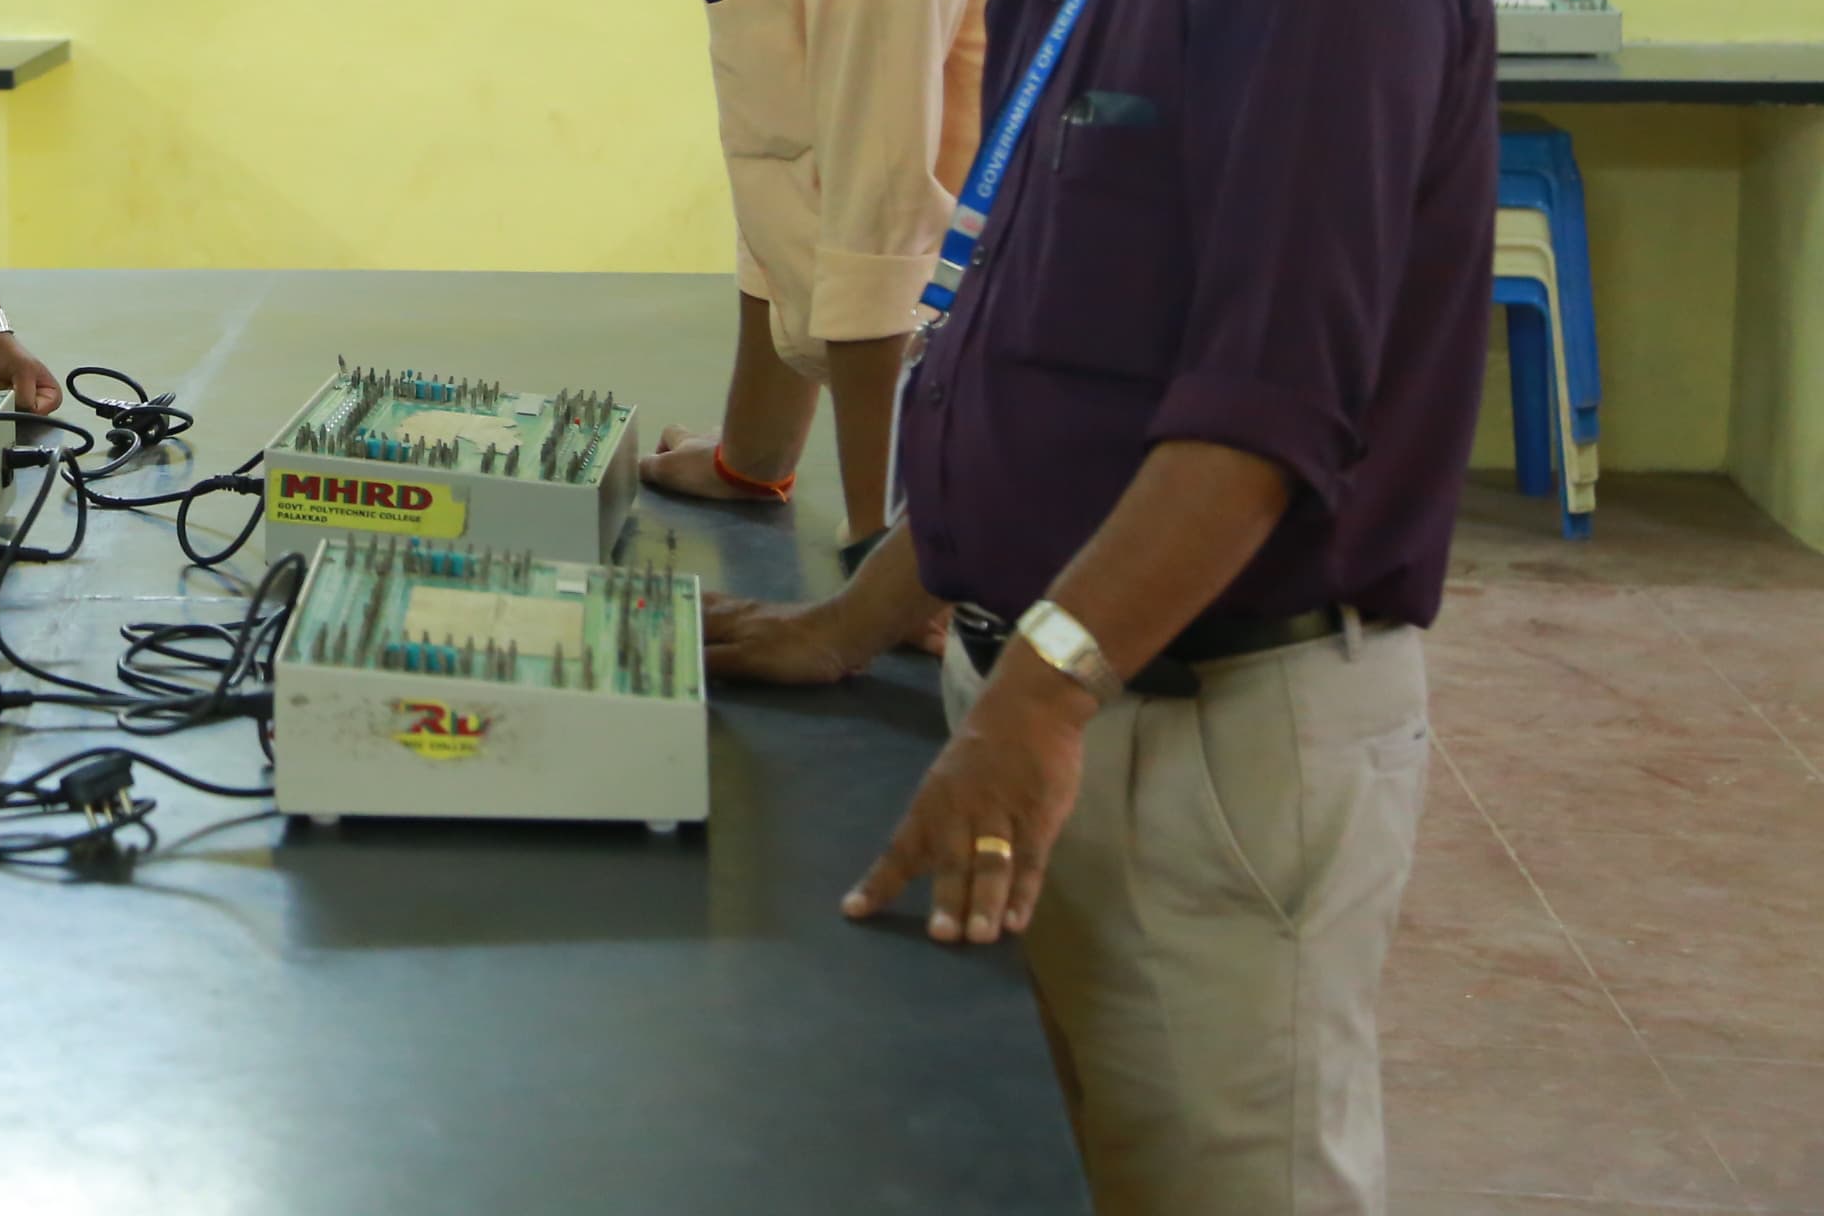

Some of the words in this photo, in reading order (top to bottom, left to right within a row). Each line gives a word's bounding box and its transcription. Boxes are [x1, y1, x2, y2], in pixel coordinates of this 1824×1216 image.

[976, 72, 1041, 198] GOVERNMENT
[1038, 45, 1055, 69] OF
[280, 473, 434, 511] MHRD
[277, 501, 305, 512] GOVT.
[309, 504, 377, 519] POLYTECHNIC
[379, 511, 422, 523] COLLEGE
[277, 511, 328, 524] PALAKKAD
